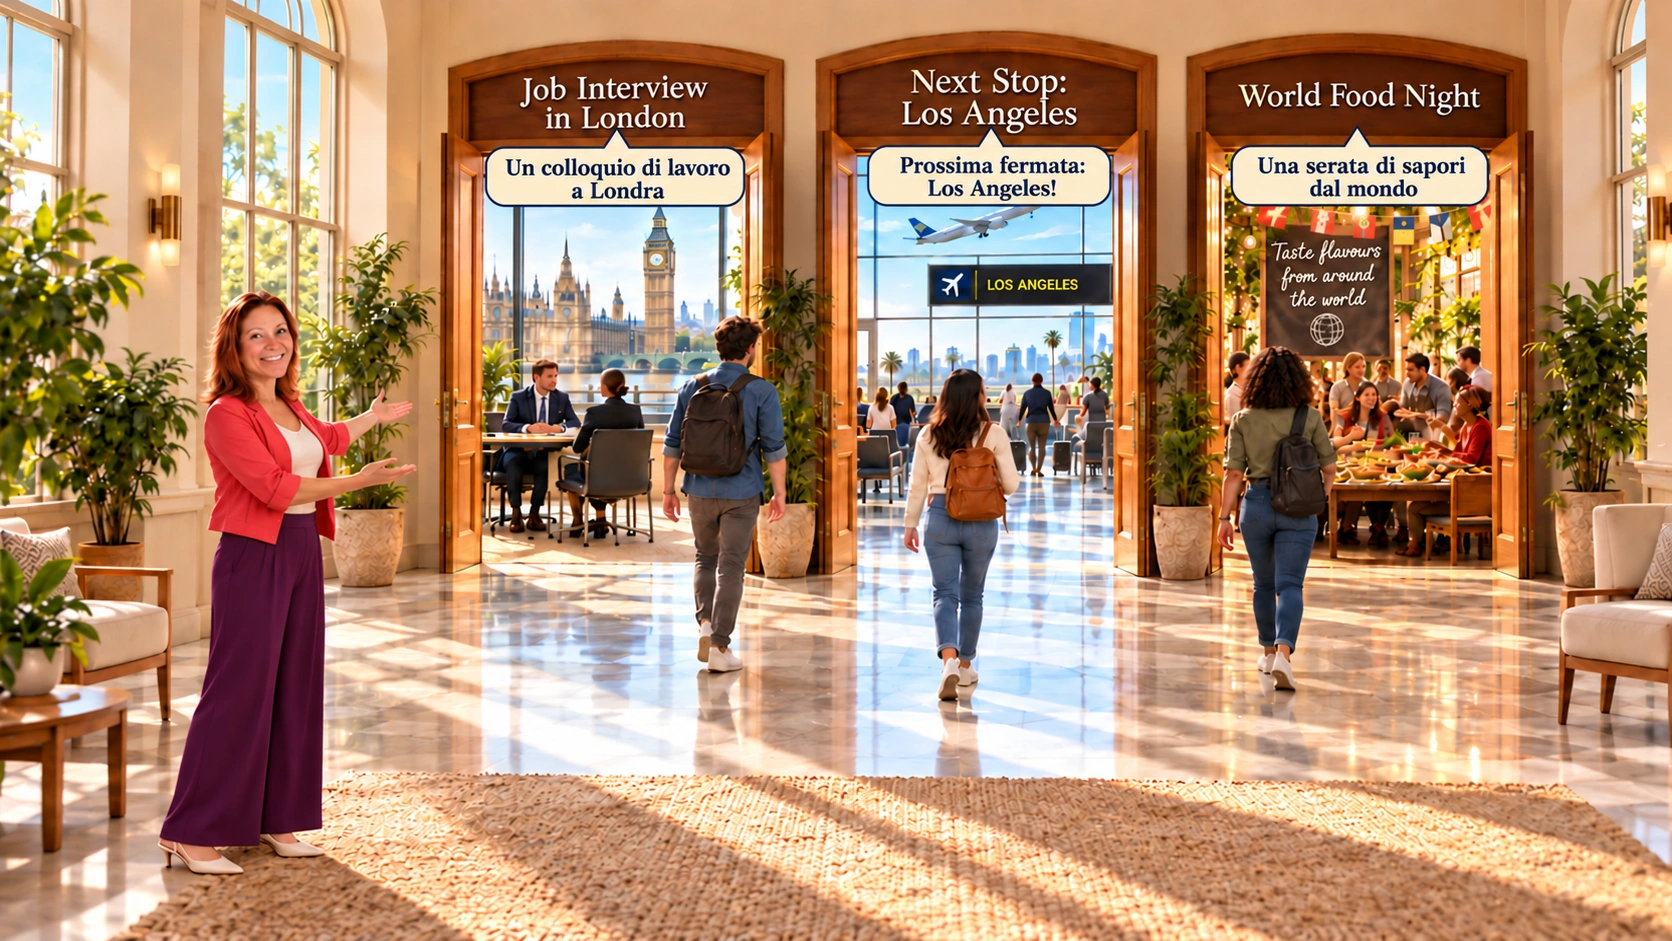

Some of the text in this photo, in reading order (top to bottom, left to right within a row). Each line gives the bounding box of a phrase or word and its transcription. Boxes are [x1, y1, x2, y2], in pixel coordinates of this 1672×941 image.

[519, 75, 708, 108] Job Interview
[911, 67, 1066, 101] Next Stop:
[1238, 82, 1480, 116] World Food Night
[546, 103, 685, 129] in London
[902, 98, 1077, 134] Los Angeles
[1271, 239, 1382, 265] Taste flavours
[987, 278, 1079, 291] LOS ANGELES
[1281, 263, 1375, 291] from around
[1289, 287, 1367, 307] the world
